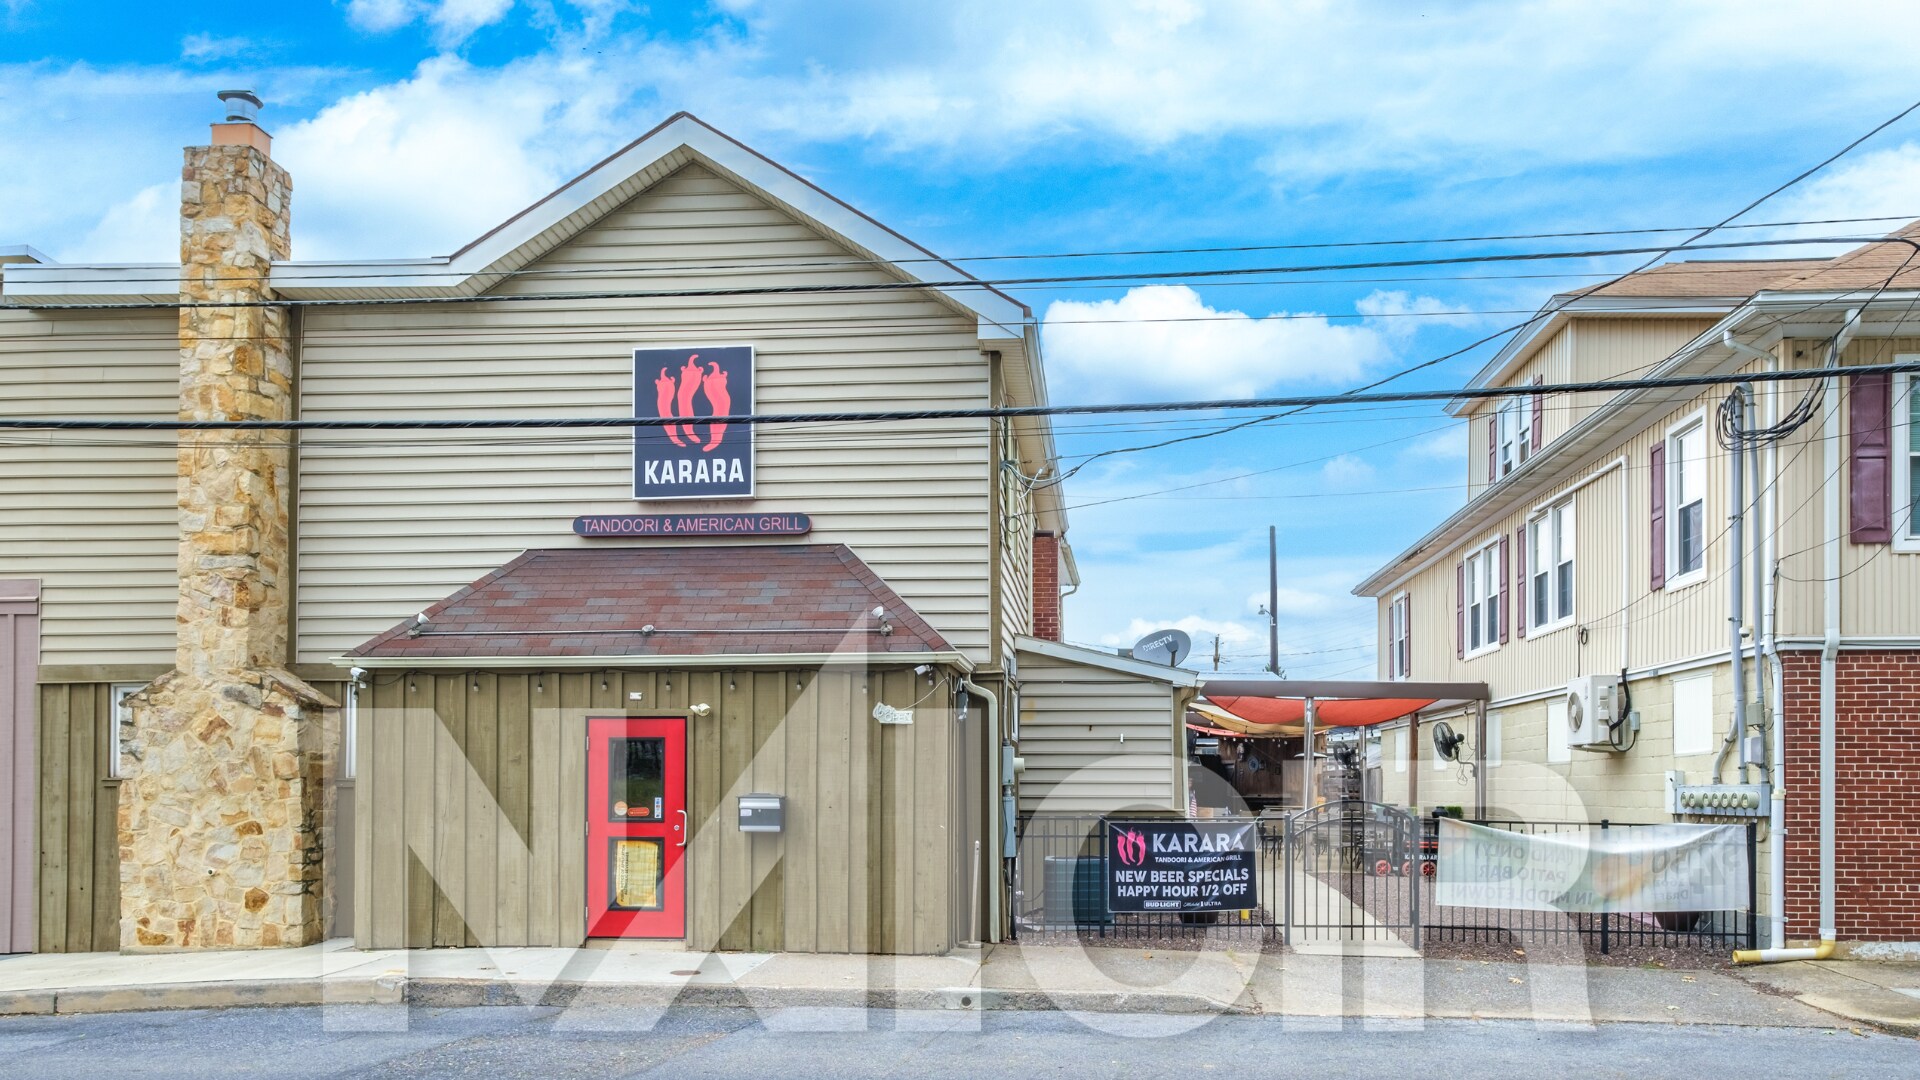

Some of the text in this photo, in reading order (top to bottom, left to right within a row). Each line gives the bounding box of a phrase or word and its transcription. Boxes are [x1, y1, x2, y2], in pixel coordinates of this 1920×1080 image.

[645, 458, 744, 484] KARARA
[582, 516, 803, 532] TANDOORI & AMERICAN GRILL
[1142, 635, 1172, 652] DIRECTV
[1153, 833, 1245, 853] KARARA
[1115, 868, 1249, 883] NEW BEER SPECIALS
[1118, 884, 1247, 897] HAPPY HOUR 1/2 OFF
